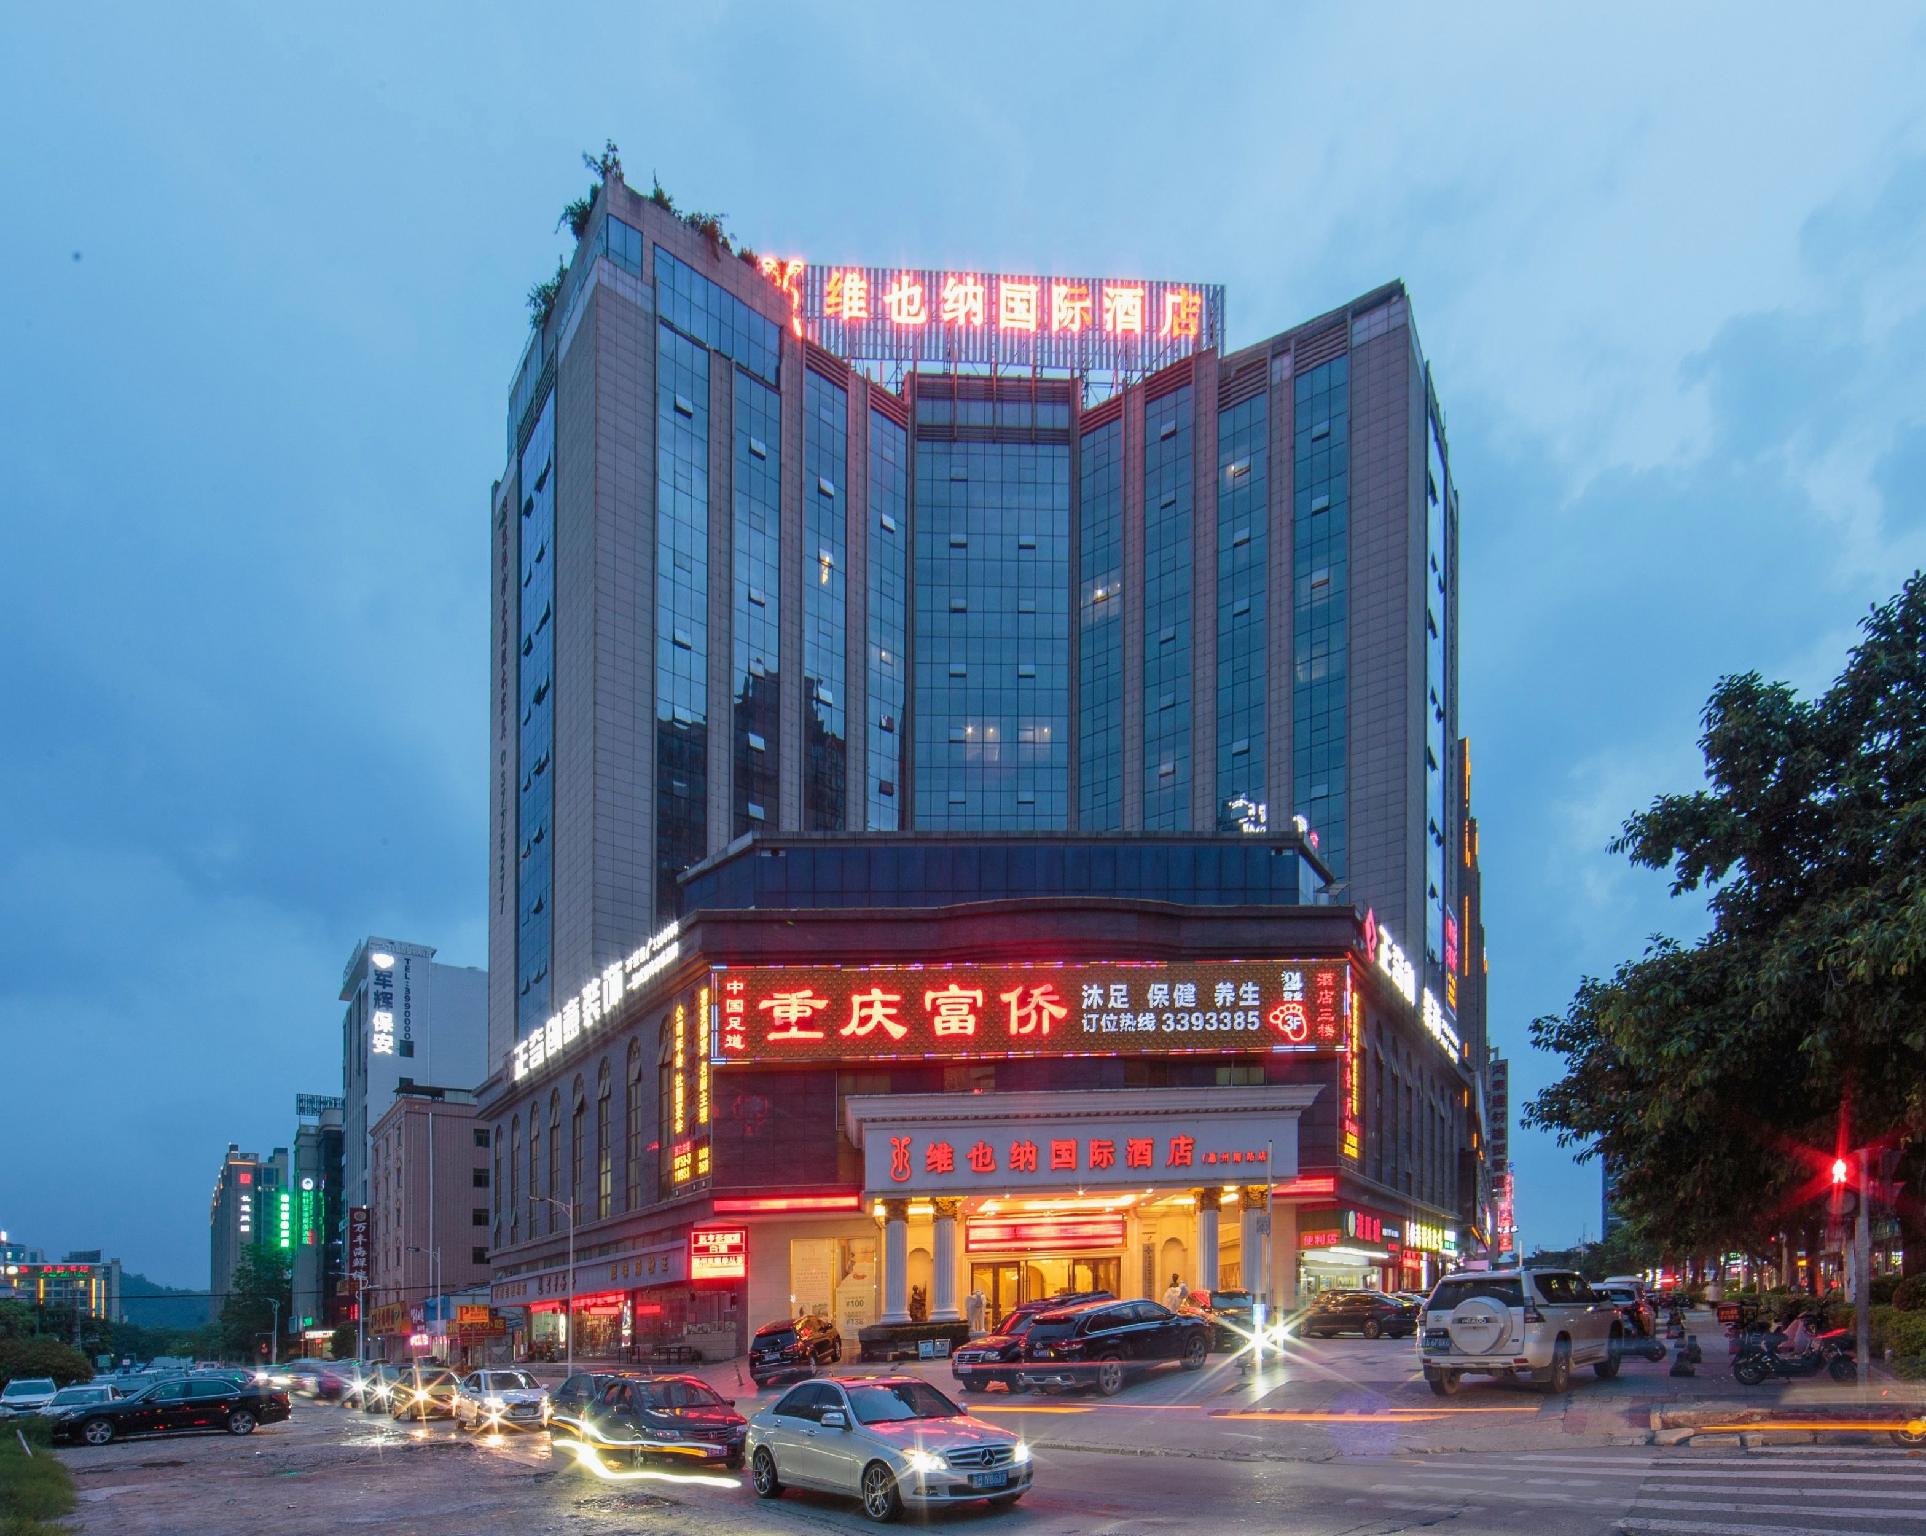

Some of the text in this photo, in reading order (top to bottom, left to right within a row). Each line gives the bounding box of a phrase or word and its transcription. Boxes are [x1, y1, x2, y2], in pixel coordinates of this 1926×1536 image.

[826, 271, 1203, 339] 维也纳国际酒店
[725, 980, 746, 1050] 中国足道
[758, 983, 1068, 1040] 重庆富侨
[1081, 984, 1130, 1009] 沐足
[1147, 983, 1196, 1008] 保健
[1214, 981, 1260, 1008] 养生
[1316, 971, 1335, 1038] 酒店三楼
[1285, 1015, 1302, 1030] 3F
[925, 1135, 1195, 1174] 维也纳国际酒店
[1303, 1230, 1339, 1246] 便利店
